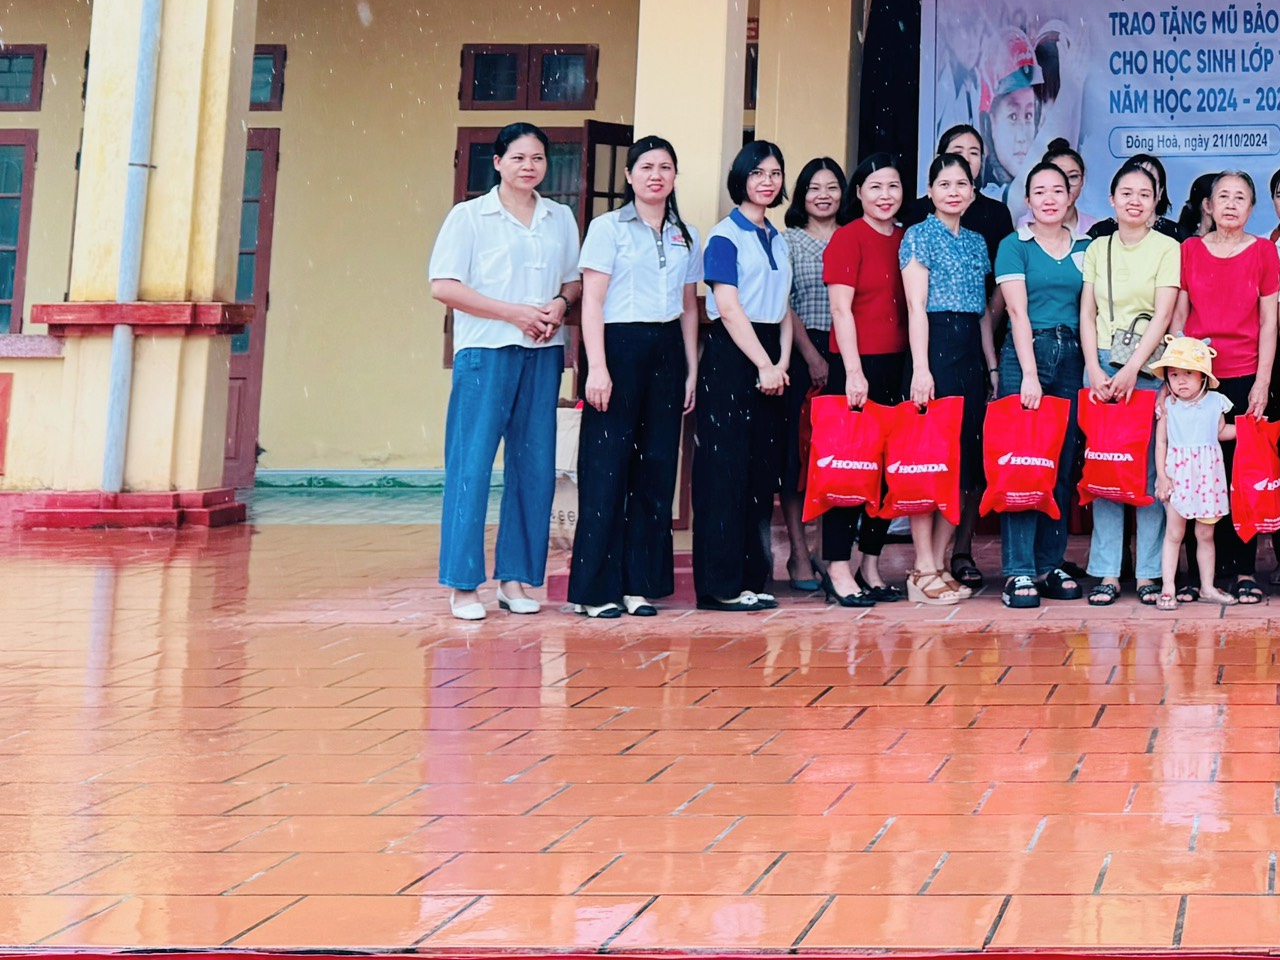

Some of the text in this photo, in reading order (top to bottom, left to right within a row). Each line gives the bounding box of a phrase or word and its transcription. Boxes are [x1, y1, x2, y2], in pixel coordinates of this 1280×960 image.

[1109, 11, 1155, 36] TRAO
[1160, 6, 1207, 42] TẶNG
[1212, 4, 1238, 34] MŨ
[1243, 2, 1279, 34] BẢO
[1109, 50, 1148, 75] CHO
[1153, 49, 1191, 81] HỌC
[1196, 49, 1236, 74] SINH
[1241, 41, 1274, 72] LỚP
[1109, 84, 1148, 114] NĂM
[1153, 88, 1191, 120] HỌC
[1196, 88, 1238, 112] 2024
[1126, 133, 1268, 151] Đông Hoà, ngày 21/10/2024
[1011, 456, 1055, 468] HONDA
[1088, 451, 1134, 462] HONDA
[832, 460, 879, 470] HONDA
[897, 463, 949, 473] HONDA
